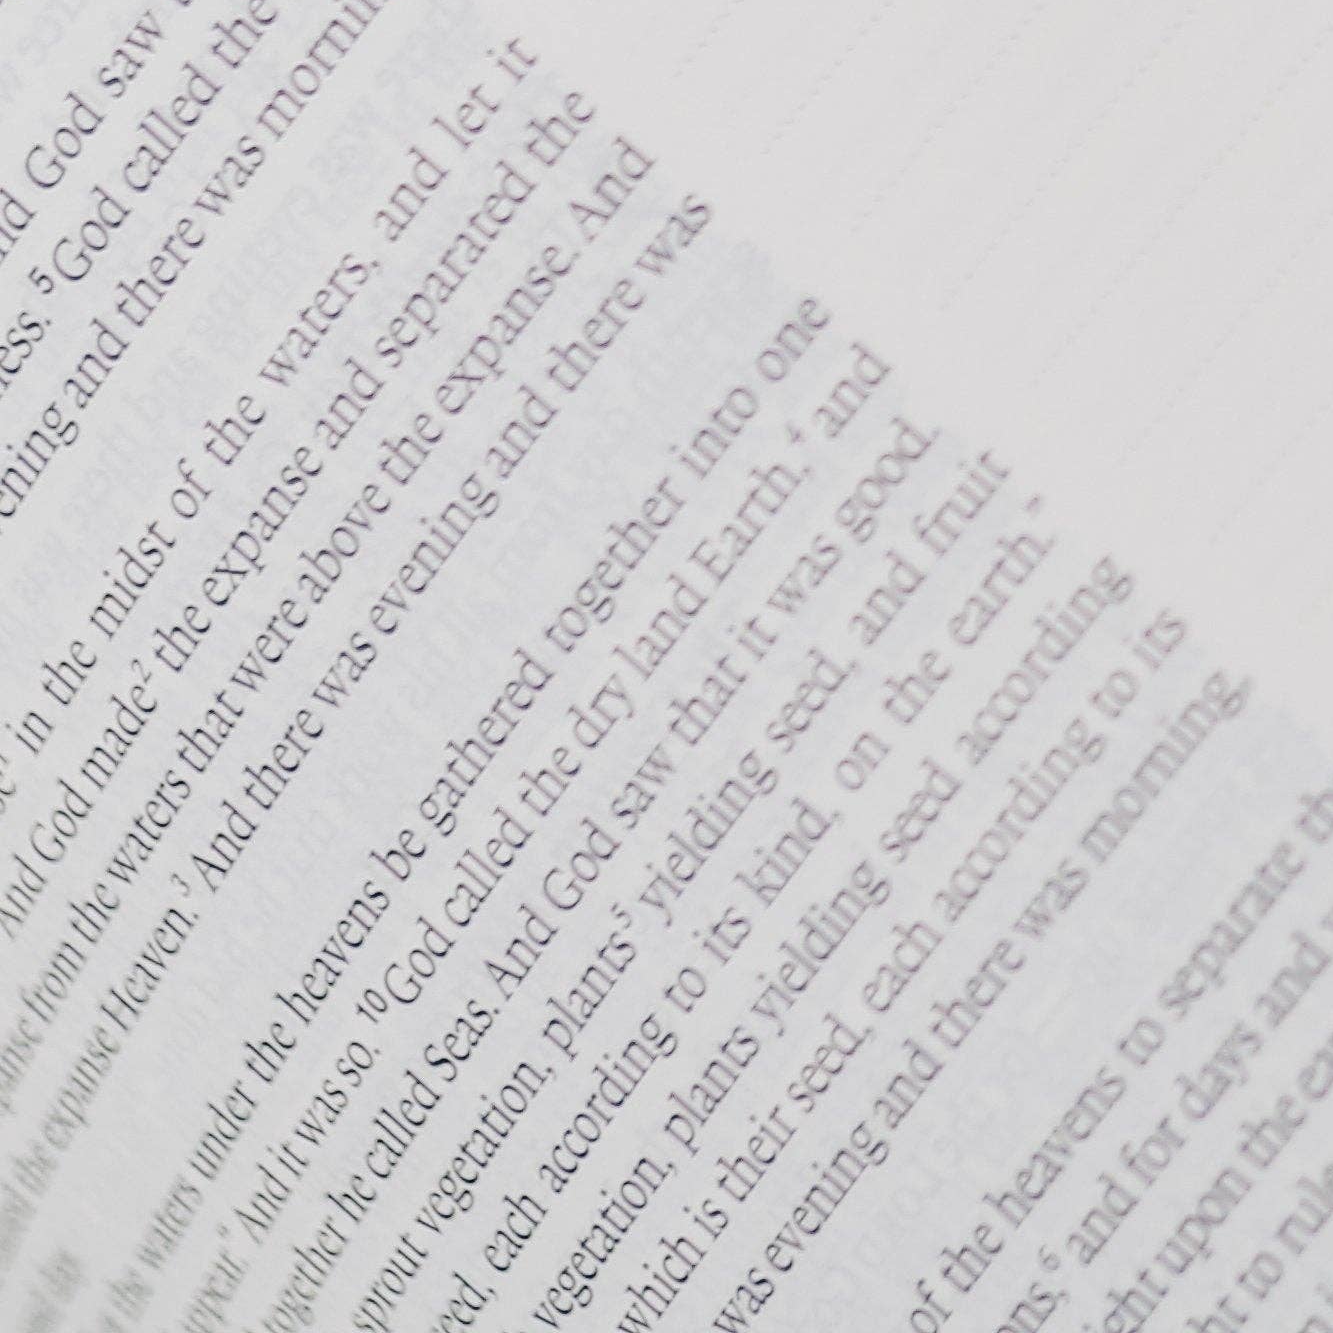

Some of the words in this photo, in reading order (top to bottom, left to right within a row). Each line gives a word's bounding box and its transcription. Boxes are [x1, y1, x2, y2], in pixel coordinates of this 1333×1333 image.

[4, 710, 55, 756] in
[41, 640, 99, 707] the
[88, 520, 178, 641] midst
[169, 456, 214, 521] of
[203, 394, 268, 468] the
[373, 144, 451, 244] and
[430, 83, 503, 153] let
[485, 36, 540, 86] it
[23, 90, 106, 191] God
[97, 8, 165, 100] saw
[63, 316, 131, 411] and
[115, 217, 206, 329] there
[191, 134, 266, 217] was
[122, 60, 224, 194] called
[19, 940, 88, 1026] from
[67, 882, 121, 945] the
[105, 768, 192, 885] waters
[176, 688, 246, 775] that
[228, 597, 309, 692] were
[297, 482, 393, 605] above
[377, 412, 445, 487] the
[567, 135, 657, 244] And
[29, 777, 95, 864] God
[152, 604, 213, 674] the
[202, 445, 325, 608] expanse
[314, 355, 386, 452] and
[374, 158, 539, 370] separated
[522, 90, 597, 169] the
[187, 1079, 258, 1182] under
[243, 1021, 298, 1085] the
[273, 879, 391, 1027] heavens
[368, 828, 429, 883] be
[418, 646, 557, 839] gathered
[542, 474, 687, 655] together
[668, 384, 760, 482] into
[753, 296, 832, 385] one
[190, 798, 260, 894] And
[242, 708, 325, 812] there
[310, 630, 379, 709] was
[369, 470, 501, 636] evening
[484, 382, 561, 480] and
[543, 276, 648, 394] there
[632, 192, 713, 277] was
[233, 1162, 293, 1245] And
[266, 1142, 311, 1180] it
[293, 1078, 349, 1147] was
[443, 805, 535, 929] called
[517, 745, 584, 818] the
[565, 672, 636, 751] dry
[610, 571, 711, 683] land
[812, 340, 894, 441] and
[260, 1215, 350, 1332] together
[323, 1173, 378, 1225] he
[365, 1068, 443, 1181] called
[483, 902, 560, 1002] And
[541, 816, 623, 913] God
[609, 741, 677, 831] saw
[666, 652, 750, 748] that
[725, 614, 780, 663] it
[764, 532, 845, 617] was
[352, 1232, 430, 1333] sprout
[637, 748, 780, 929] yielding
[848, 547, 929, 648] and
[910, 448, 1013, 560] fruit
[483, 1193, 549, 1274] each
[538, 1011, 680, 1195] according
[662, 965, 709, 1015] to
[691, 905, 754, 967] its
[833, 730, 893, 793] on
[880, 648, 955, 728] the
[615, 1235, 708, 1333] which
[681, 1197, 731, 1242] is
[715, 1103, 798, 1204] their
[861, 919, 947, 1016] each
[932, 715, 1110, 926] according
[1086, 667, 1142, 722] to
[1121, 606, 1190, 674] its
[662, 1024, 762, 1158] plants
[749, 858, 893, 1039] yielding
[878, 755, 965, 864] seed
[955, 554, 1136, 768] according
[711, 1266, 776, 1333] was
[764, 1119, 891, 1274] evening
[872, 1036, 947, 1131] and
[928, 937, 1028, 1051] there
[1009, 856, 1091, 942] was
